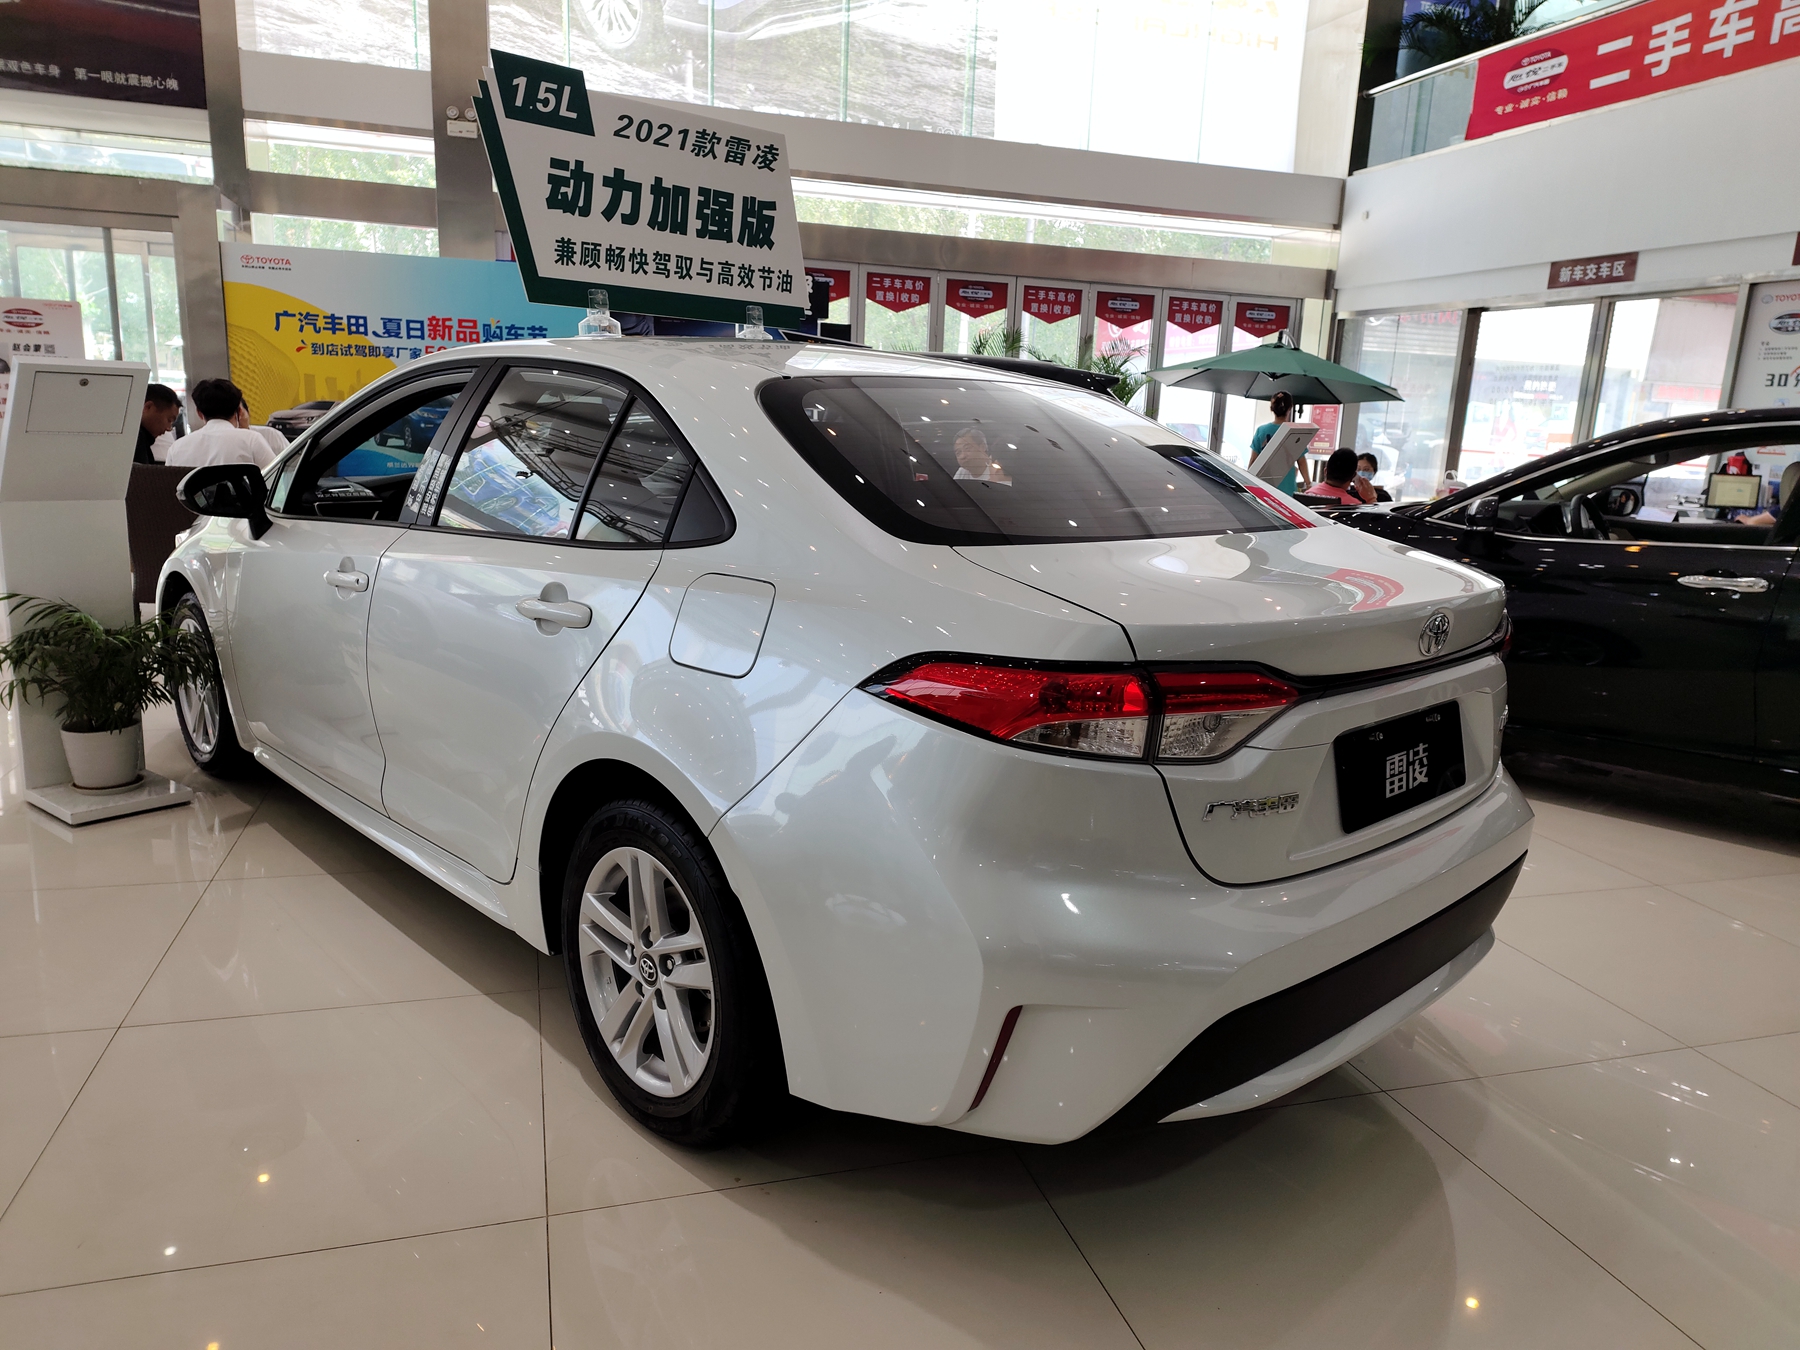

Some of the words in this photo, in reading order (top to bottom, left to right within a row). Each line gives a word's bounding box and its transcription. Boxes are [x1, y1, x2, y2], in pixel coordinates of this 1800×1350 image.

[511, 76, 578, 119] 1.5L
[613, 114, 780, 172] 2021款雷凌
[545, 157, 777, 250] 动力加强版
[255, 256, 292, 266] TOYOTA
[554, 237, 794, 294] 兼顾畅快驾驭与高效节油
[1558, 261, 1626, 282] 新车交车区
[872, 277, 924, 291] 二手车高价
[1028, 290, 1076, 303] 二手车高价
[1172, 301, 1217, 313] 二手车高价
[1386, 743, 1428, 798] 雷凌
